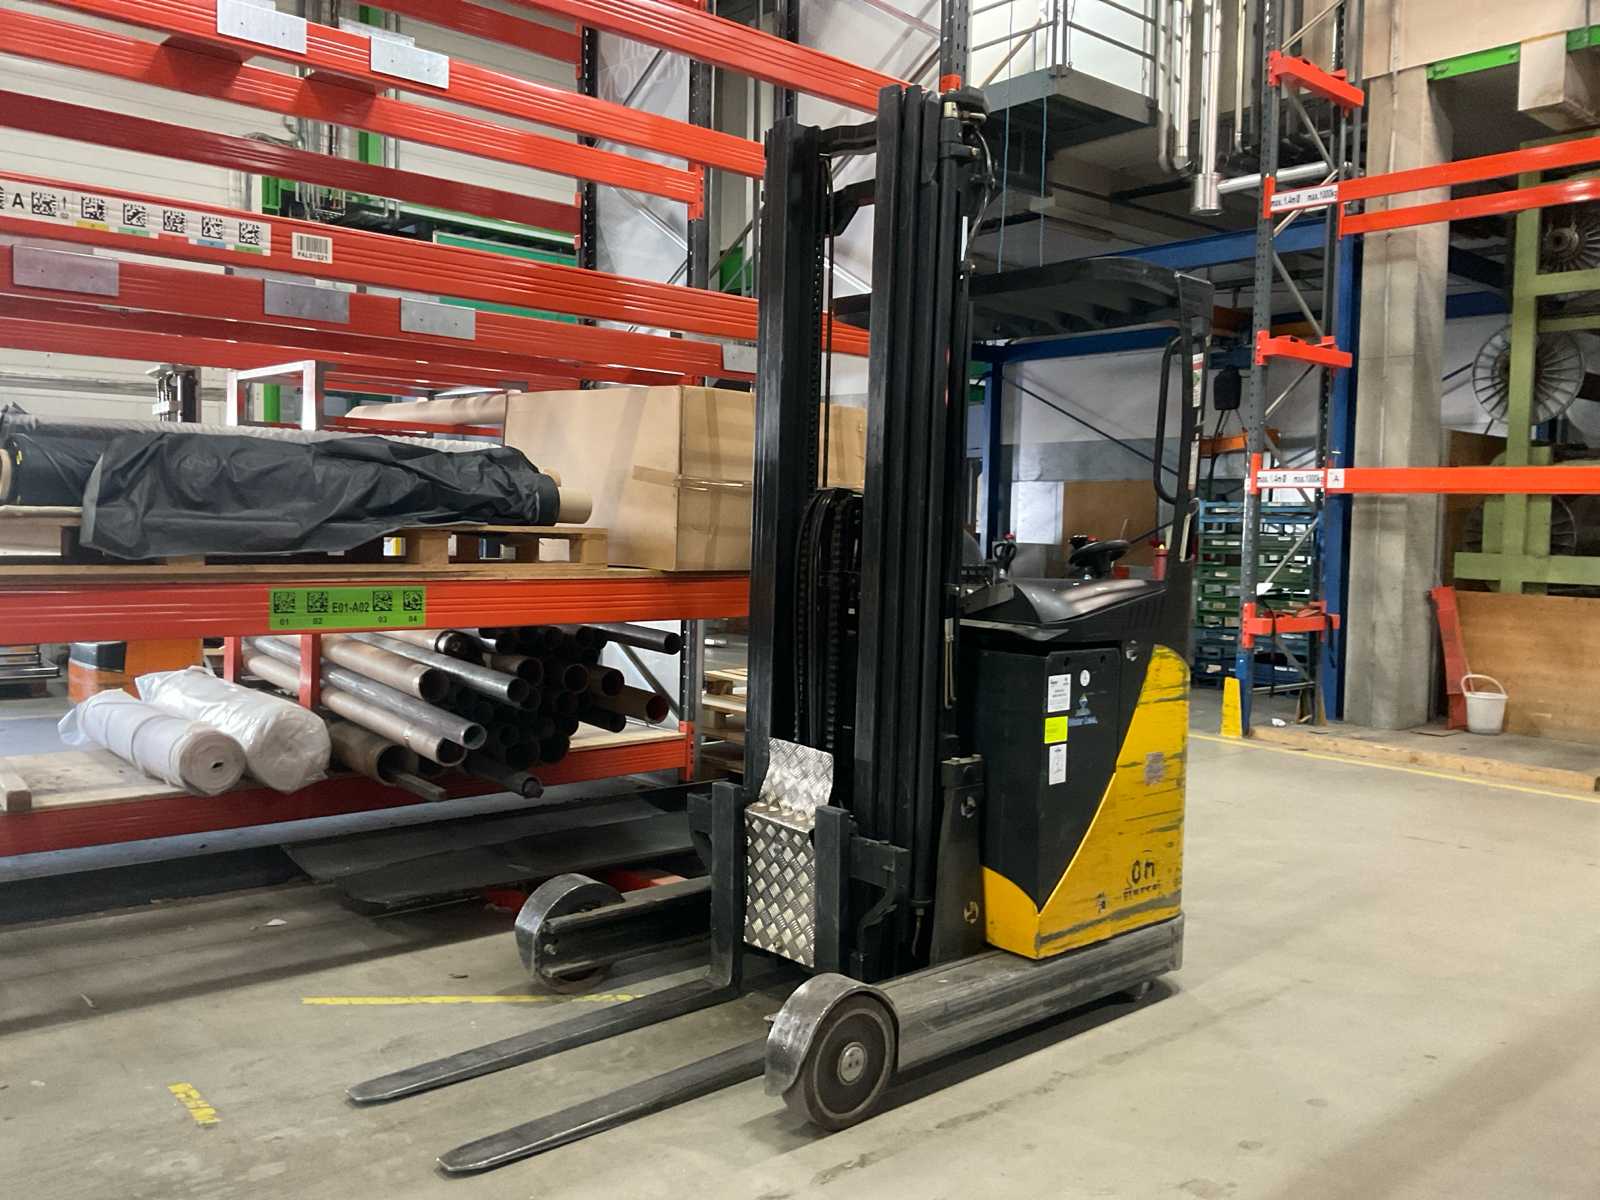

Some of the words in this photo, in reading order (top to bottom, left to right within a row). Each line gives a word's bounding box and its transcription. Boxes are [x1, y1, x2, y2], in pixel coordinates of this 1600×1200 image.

[12, 193, 24, 209] A
[331, 601, 370, 613] E01-A02
[279, 618, 290, 626] 01
[312, 617, 323, 625] 02
[377, 615, 388, 623] 03
[408, 615, 418, 623] 04
